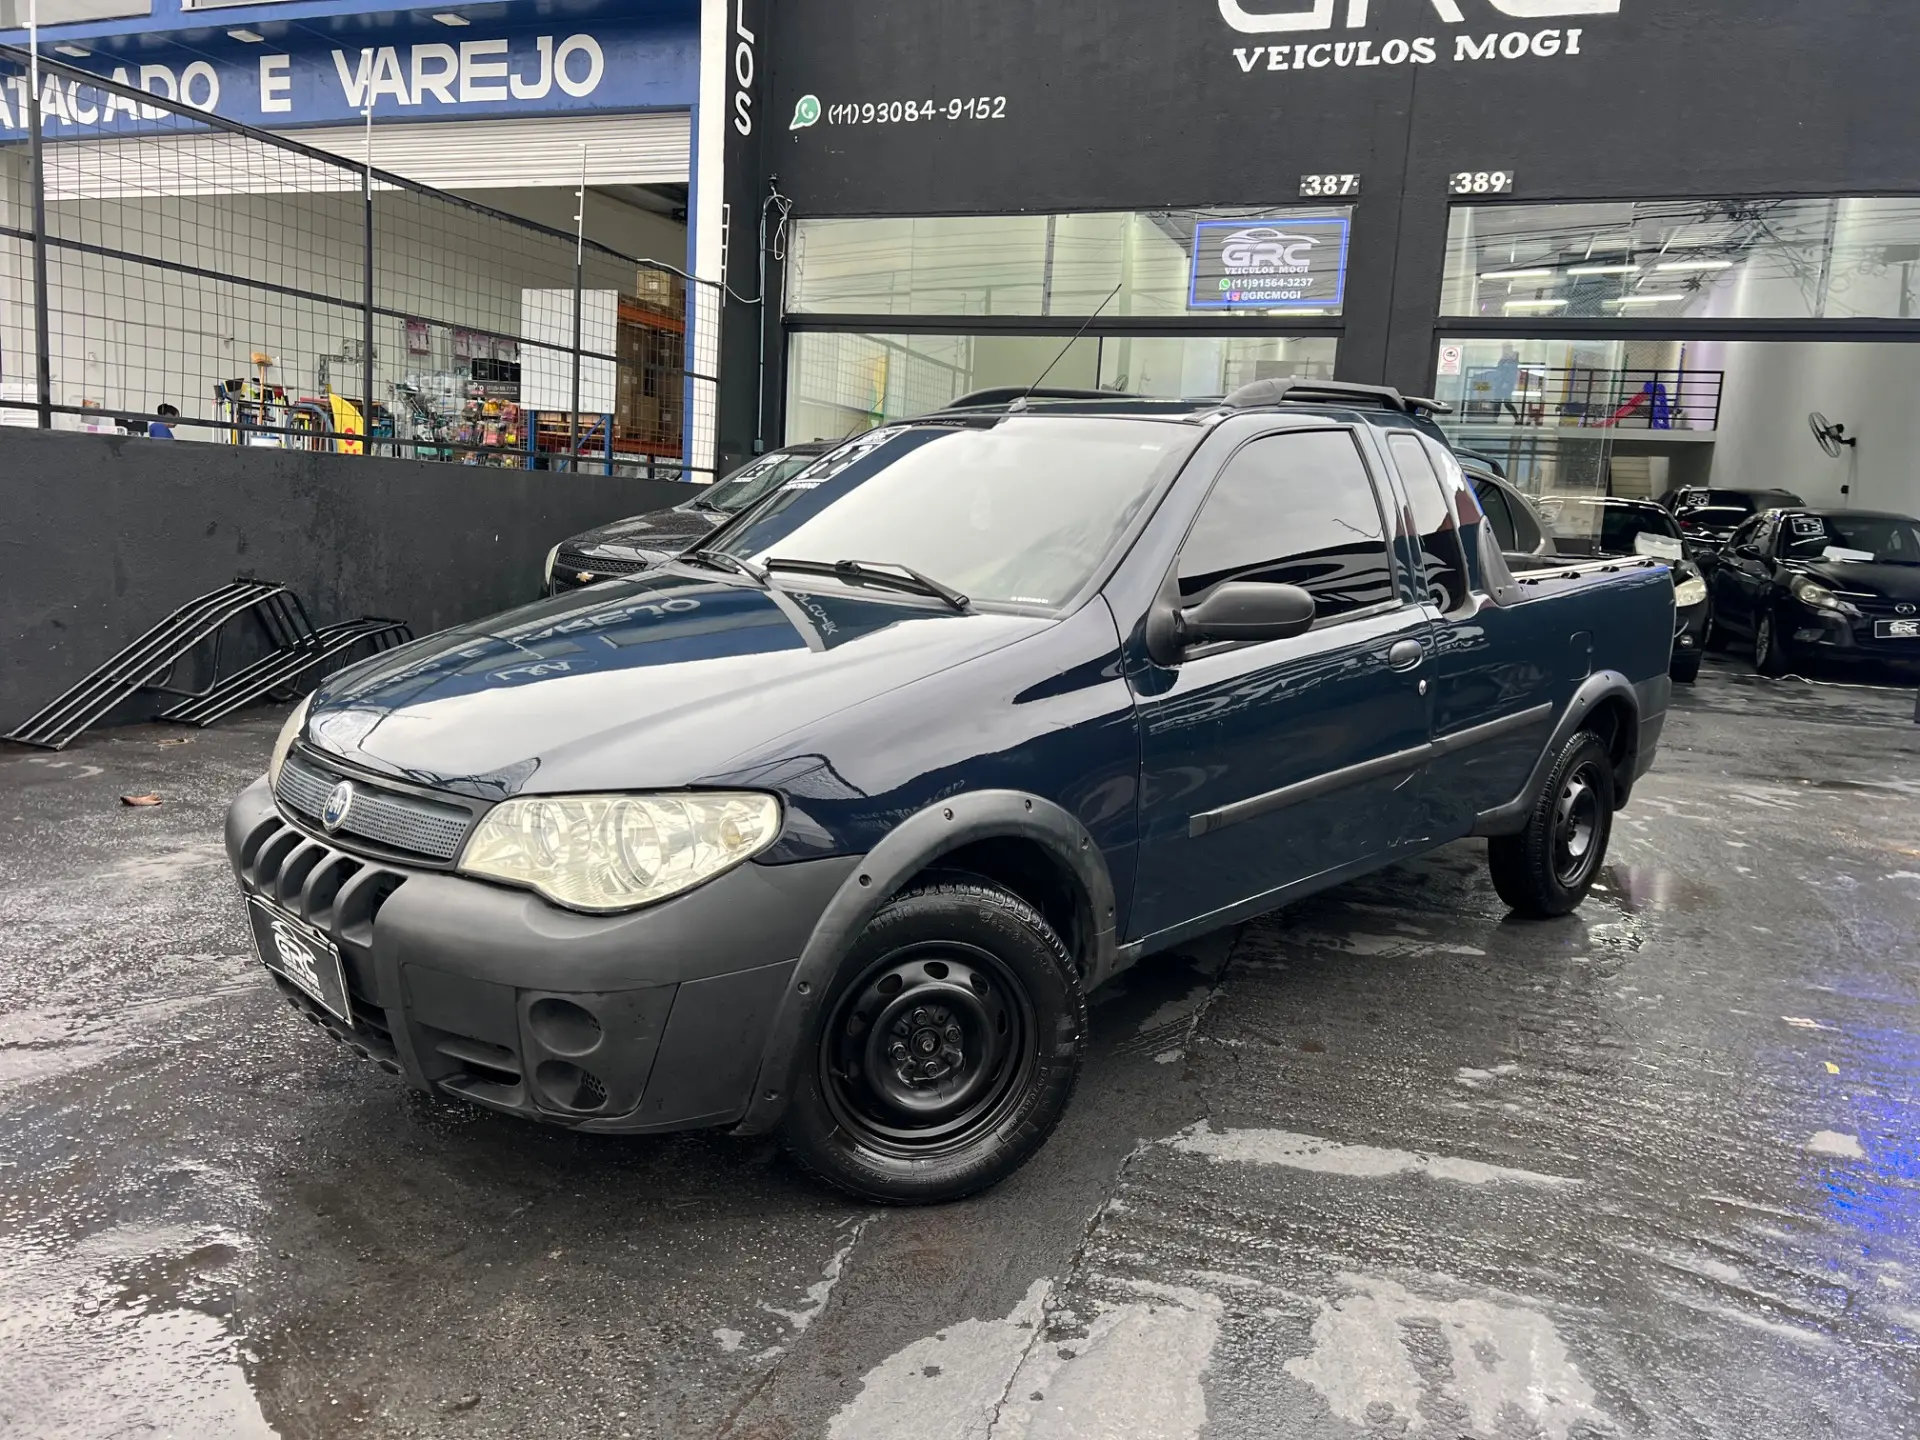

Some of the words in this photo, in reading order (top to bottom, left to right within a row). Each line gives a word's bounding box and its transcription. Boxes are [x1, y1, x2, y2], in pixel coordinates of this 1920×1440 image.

[1232, 36, 1437, 73] VEICULOS
[1453, 28, 1583, 63] MOGI
[259, 54, 292, 113] E
[331, 33, 605, 108] VAREJO
[827, 95, 1008, 126] (11)93084-9152
[1304, 174, 1355, 196] 387
[1454, 171, 1507, 194] 389
[1221, 242, 1312, 267] GRC
[1224, 266, 1275, 274] VEICULOS
[1231, 278, 1314, 289] (11)91564-3237
[1241, 290, 1302, 300] @GRCMOGI
[274, 931, 319, 982] GRC
